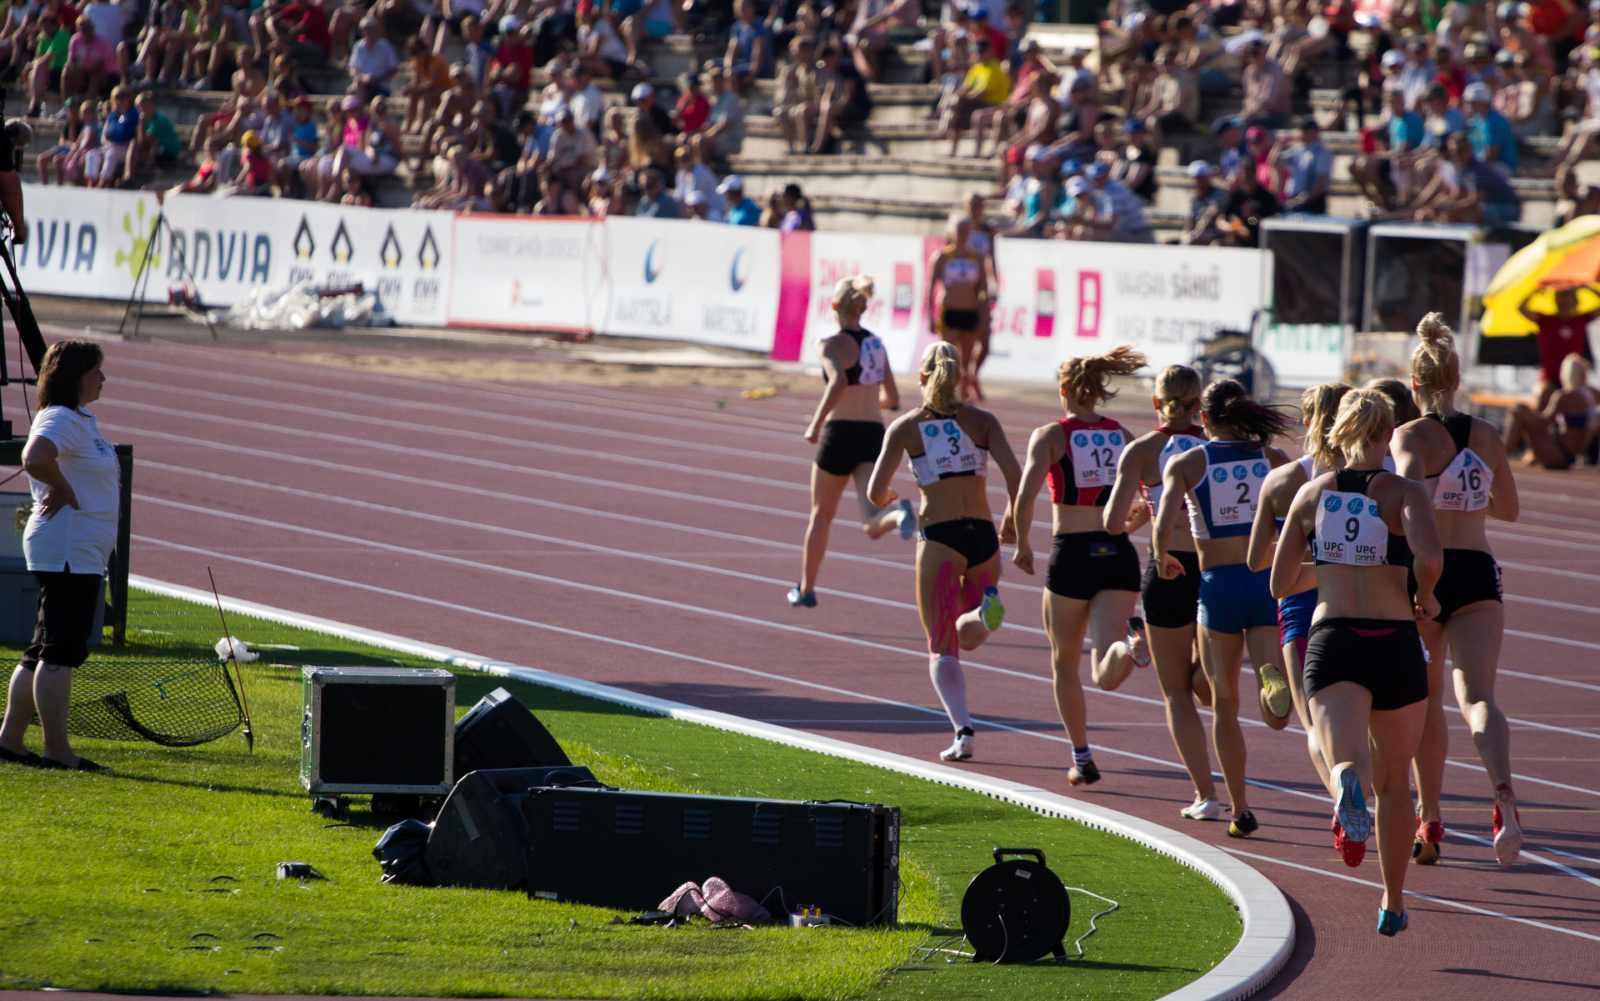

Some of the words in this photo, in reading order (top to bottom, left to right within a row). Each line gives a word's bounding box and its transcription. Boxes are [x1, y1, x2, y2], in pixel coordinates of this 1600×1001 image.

[166, 228, 270, 283] ANVIA
[947, 436, 960, 456] 3
[1090, 447, 1115, 468] 12
[1082, 469, 1100, 478] UPC
[1457, 468, 1481, 491] 16
[1235, 482, 1251, 505] 2
[1443, 491, 1464, 501] UPC
[1219, 506, 1239, 515] UPC
[1344, 517, 1360, 543] 9
[1323, 541, 1344, 552] UPC
[1355, 544, 1377, 555] UPC
[1354, 553, 1376, 563] print
